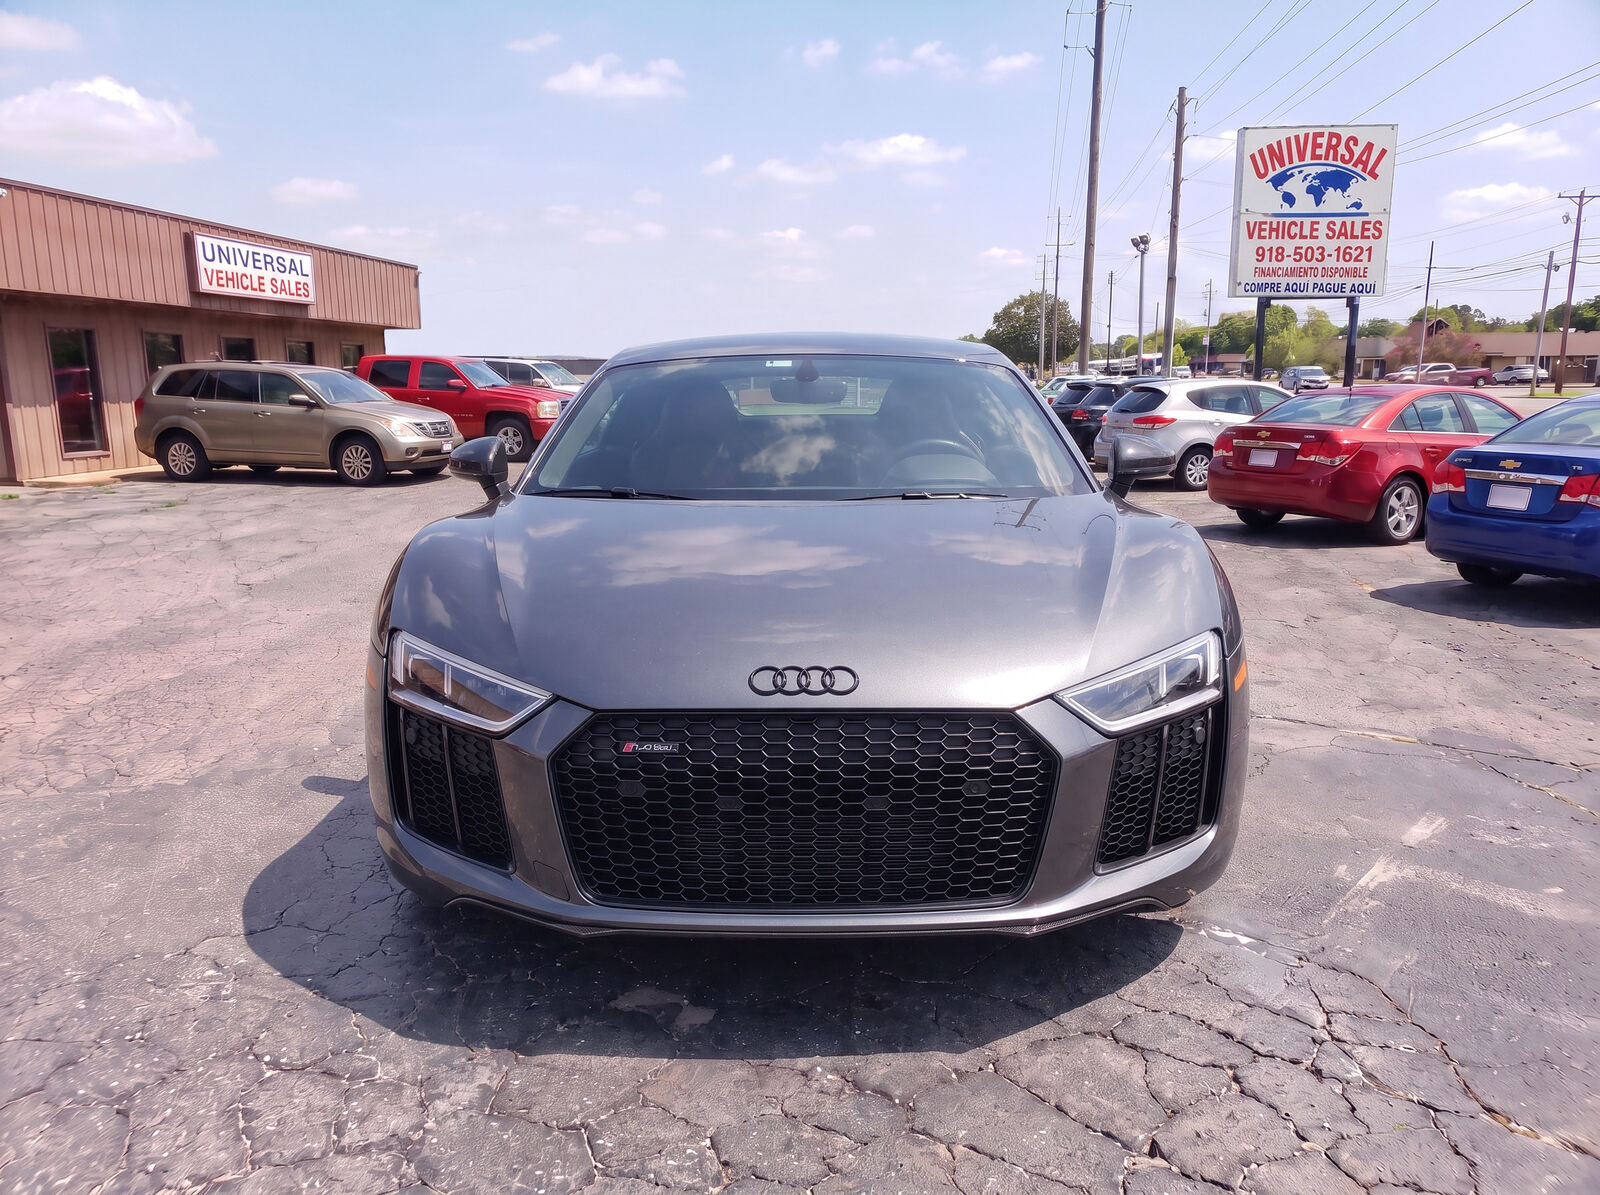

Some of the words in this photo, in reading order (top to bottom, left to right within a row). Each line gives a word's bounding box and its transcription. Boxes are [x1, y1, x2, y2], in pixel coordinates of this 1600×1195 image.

[1249, 131, 1388, 181] UNIVERSAL
[1245, 220, 1320, 240] VEHICLE
[1325, 220, 1383, 240] SALES
[201, 241, 310, 277] UNIVERSAL
[1255, 245, 1373, 263] 918-503-1621
[1253, 266, 1319, 278] FINANCIAMIENTO
[1320, 267, 1369, 278] DISPONIBLE
[203, 267, 266, 293] VEHICLE
[270, 277, 310, 298] SALES
[1243, 282, 1282, 293] COMPRE
[1284, 280, 1310, 293] AQUÍ
[1312, 282, 1347, 293] PAGUE
[1350, 281, 1377, 294] AQUÍ
